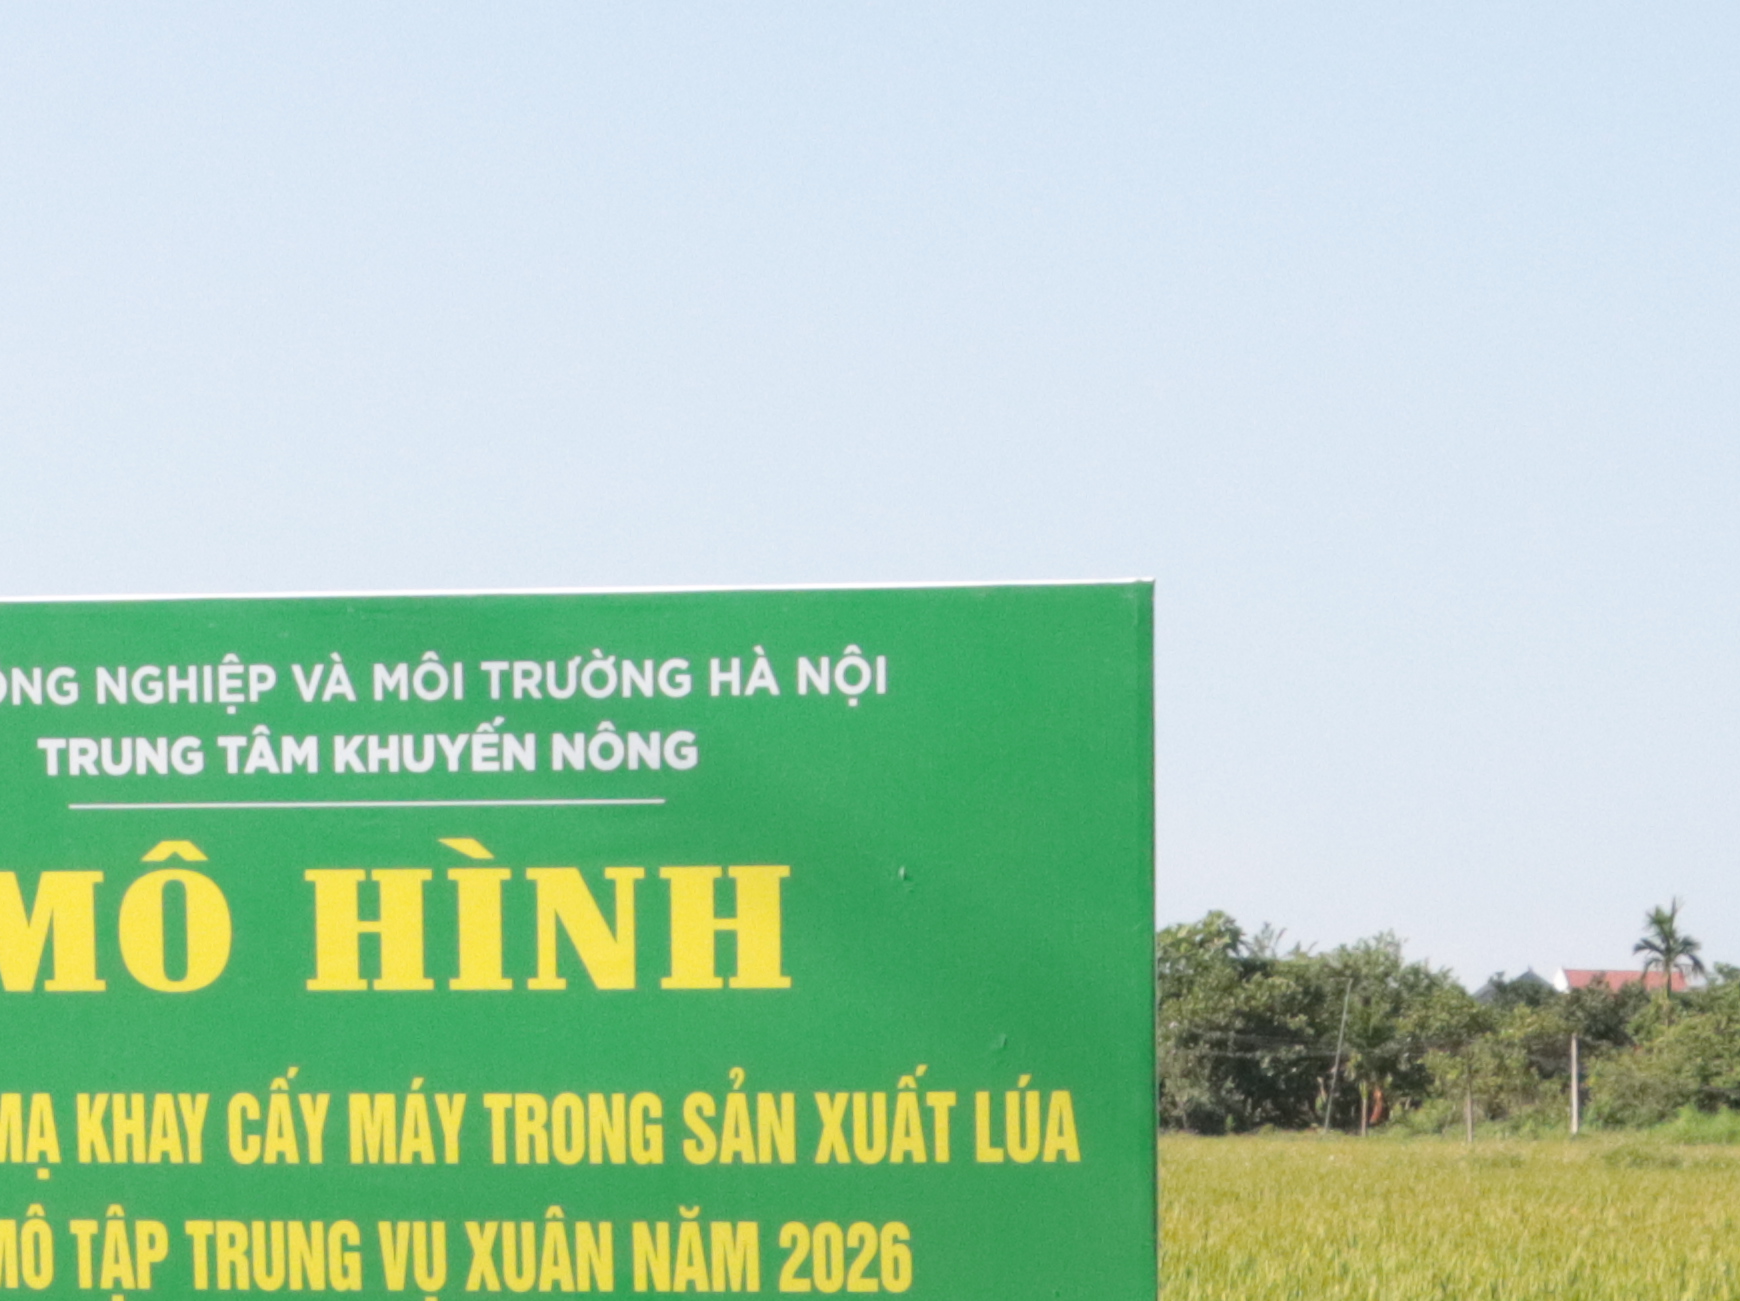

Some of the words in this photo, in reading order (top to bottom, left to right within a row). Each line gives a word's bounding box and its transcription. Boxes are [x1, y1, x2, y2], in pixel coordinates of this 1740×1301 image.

[96, 654, 276, 714] NGHIỆP
[292, 653, 356, 701] VÀ
[373, 652, 463, 701] MÔI
[481, 649, 691, 699] TRƯỜNG
[710, 647, 779, 696] HÀ
[797, 647, 886, 706] NỘI
[37, 736, 204, 776] TRUNG
[217, 725, 318, 774] TÂM
[333, 718, 535, 773] KHUYẾN
[551, 721, 697, 770] NÔNG
[304, 837, 791, 991] HÌNH
[76, 1093, 210, 1163] KHAY
[228, 1067, 330, 1164] CẤY
[349, 1077, 466, 1164] MÁY
[483, 1092, 663, 1165] TRONG
[683, 1067, 795, 1164] SẢN
[815, 1065, 956, 1164] XUẤT
[975, 1075, 1080, 1163] LÚA
[185, 1220, 362, 1291] TRUNG
[465, 1206, 613, 1292] XUÂN
[633, 1206, 760, 1292] NĂM
[779, 1222, 912, 1293] 2026
